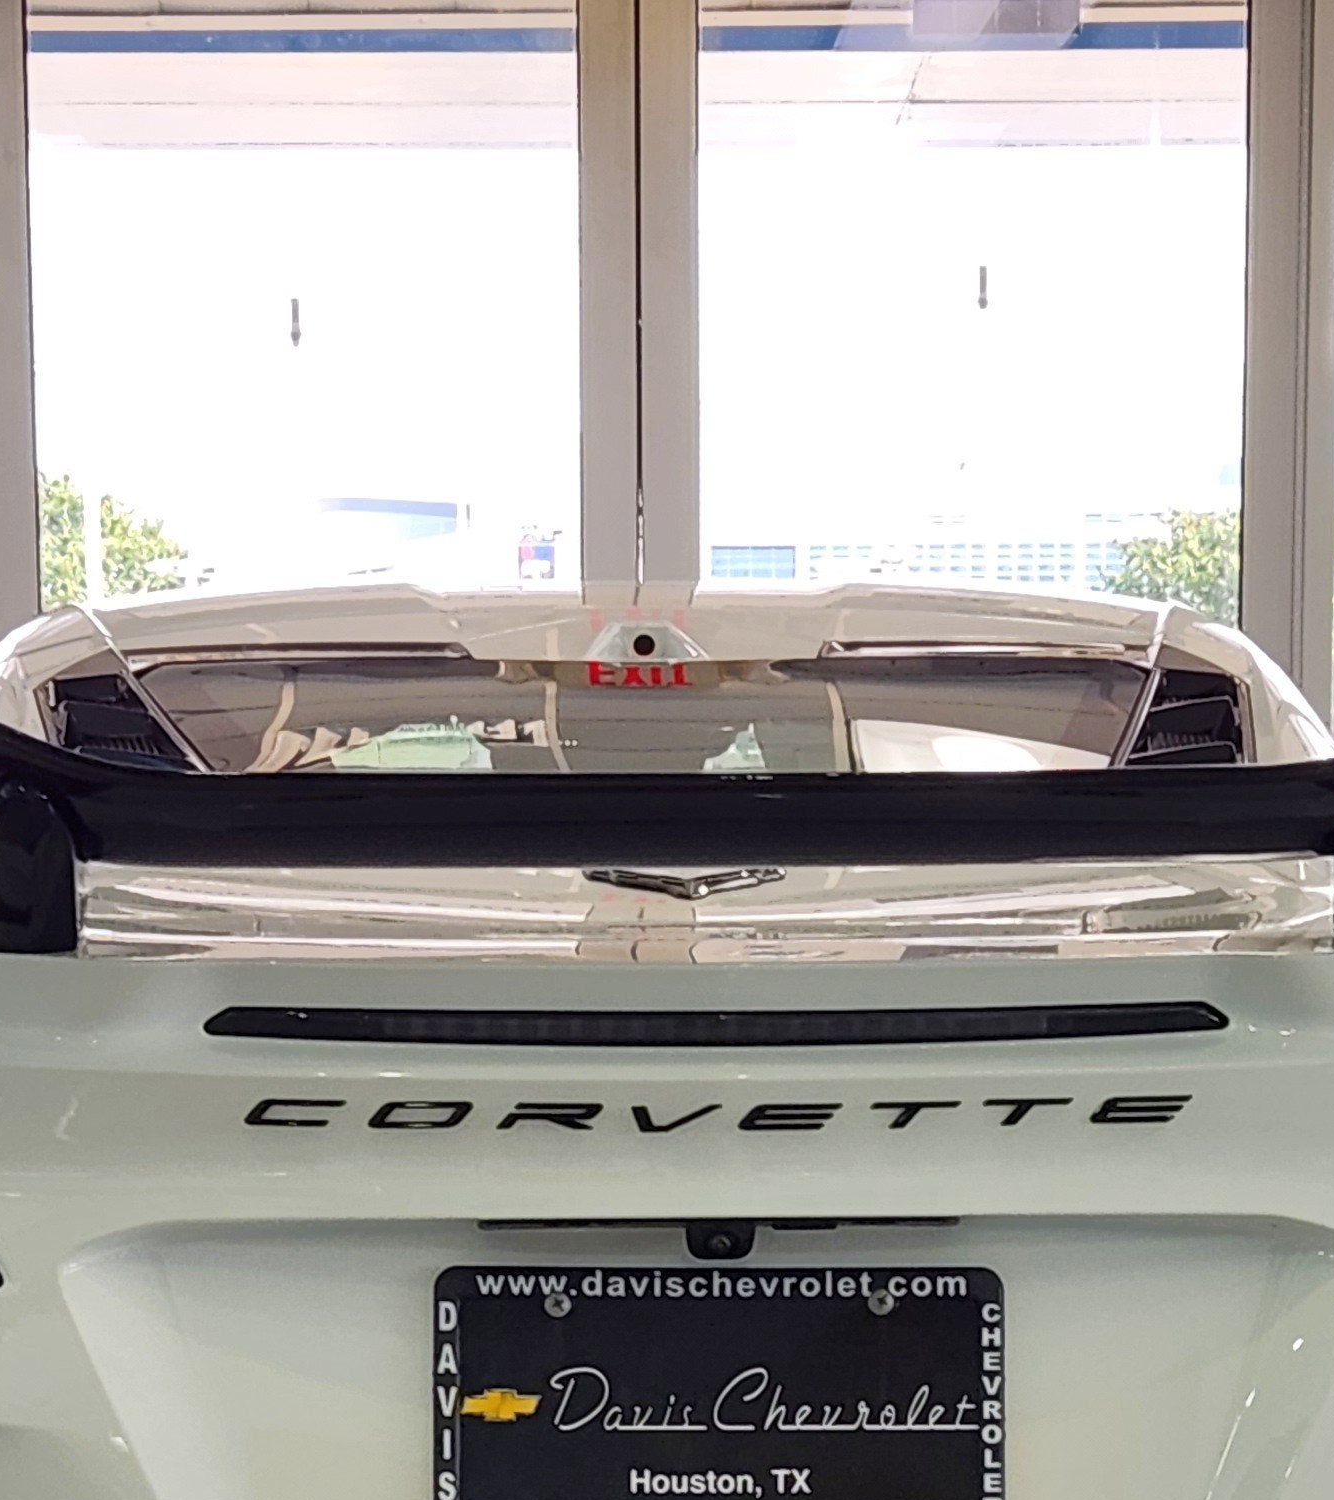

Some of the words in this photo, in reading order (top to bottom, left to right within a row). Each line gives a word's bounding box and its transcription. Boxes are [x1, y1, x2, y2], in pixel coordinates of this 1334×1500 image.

[244, 1094, 1193, 1132] CORVETTE
[475, 1269, 968, 1298] www.davischevroletcom
[549, 1366, 708, 1432] Davis
[712, 1367, 981, 1432] Chevrolet
[628, 1468, 764, 1499] Houston,
[770, 1468, 812, 1495] TX
